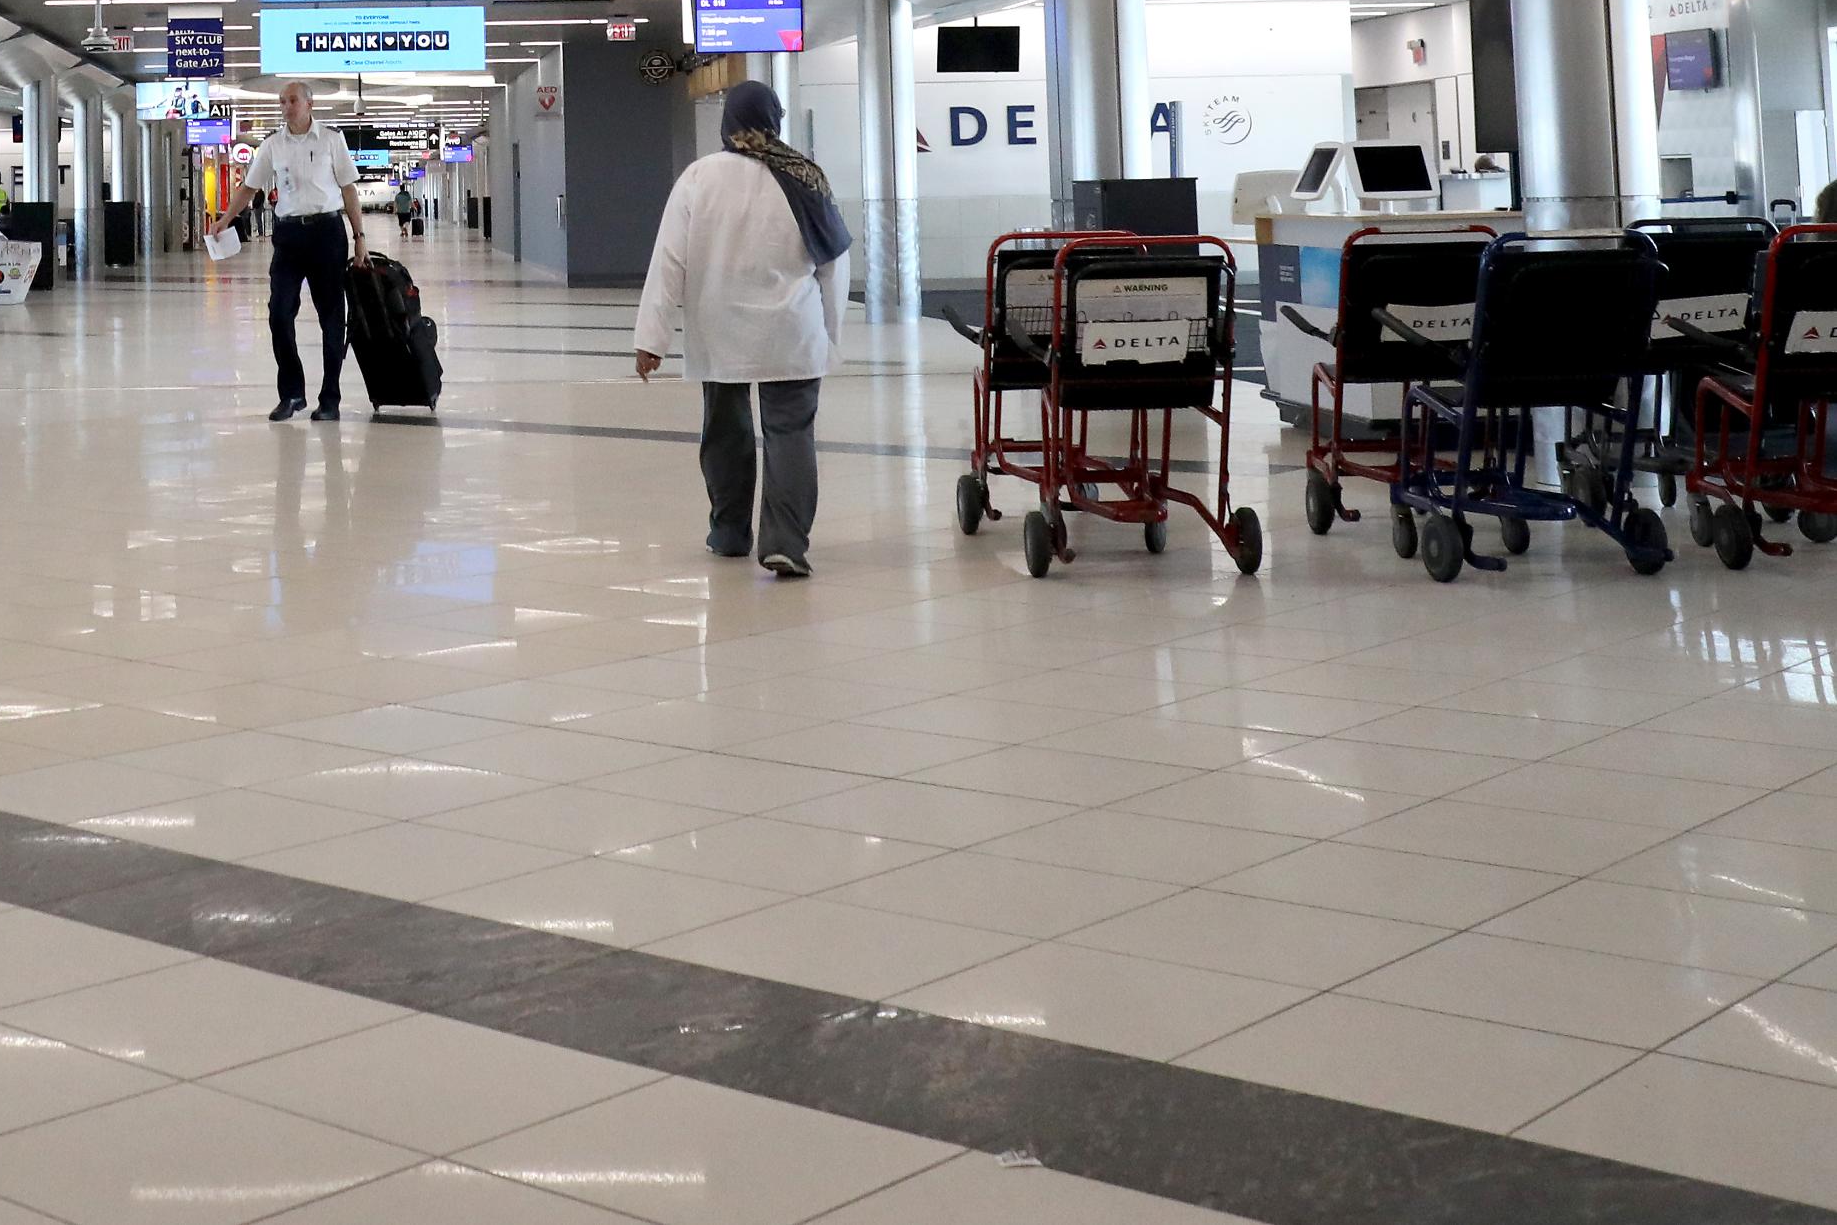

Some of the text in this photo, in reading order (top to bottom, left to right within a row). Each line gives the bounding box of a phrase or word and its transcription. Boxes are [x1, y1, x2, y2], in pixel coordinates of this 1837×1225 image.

[1678, 0, 1708, 15] DELTA
[113, 36, 130, 50] EXIT
[175, 35, 222, 44] SKY CLUB
[298, 33, 448, 49] THANK YOU
[175, 47, 210, 55] next to
[175, 58, 220, 67] Gate A17
[210, 104, 230, 116] A11
[949, 102, 1171, 146] DEA
[1124, 284, 1169, 292] WARNING
[1681, 308, 1739, 321] DELTA
[1412, 317, 1471, 328] DELTA
[1114, 336, 1180, 348] DELTA
